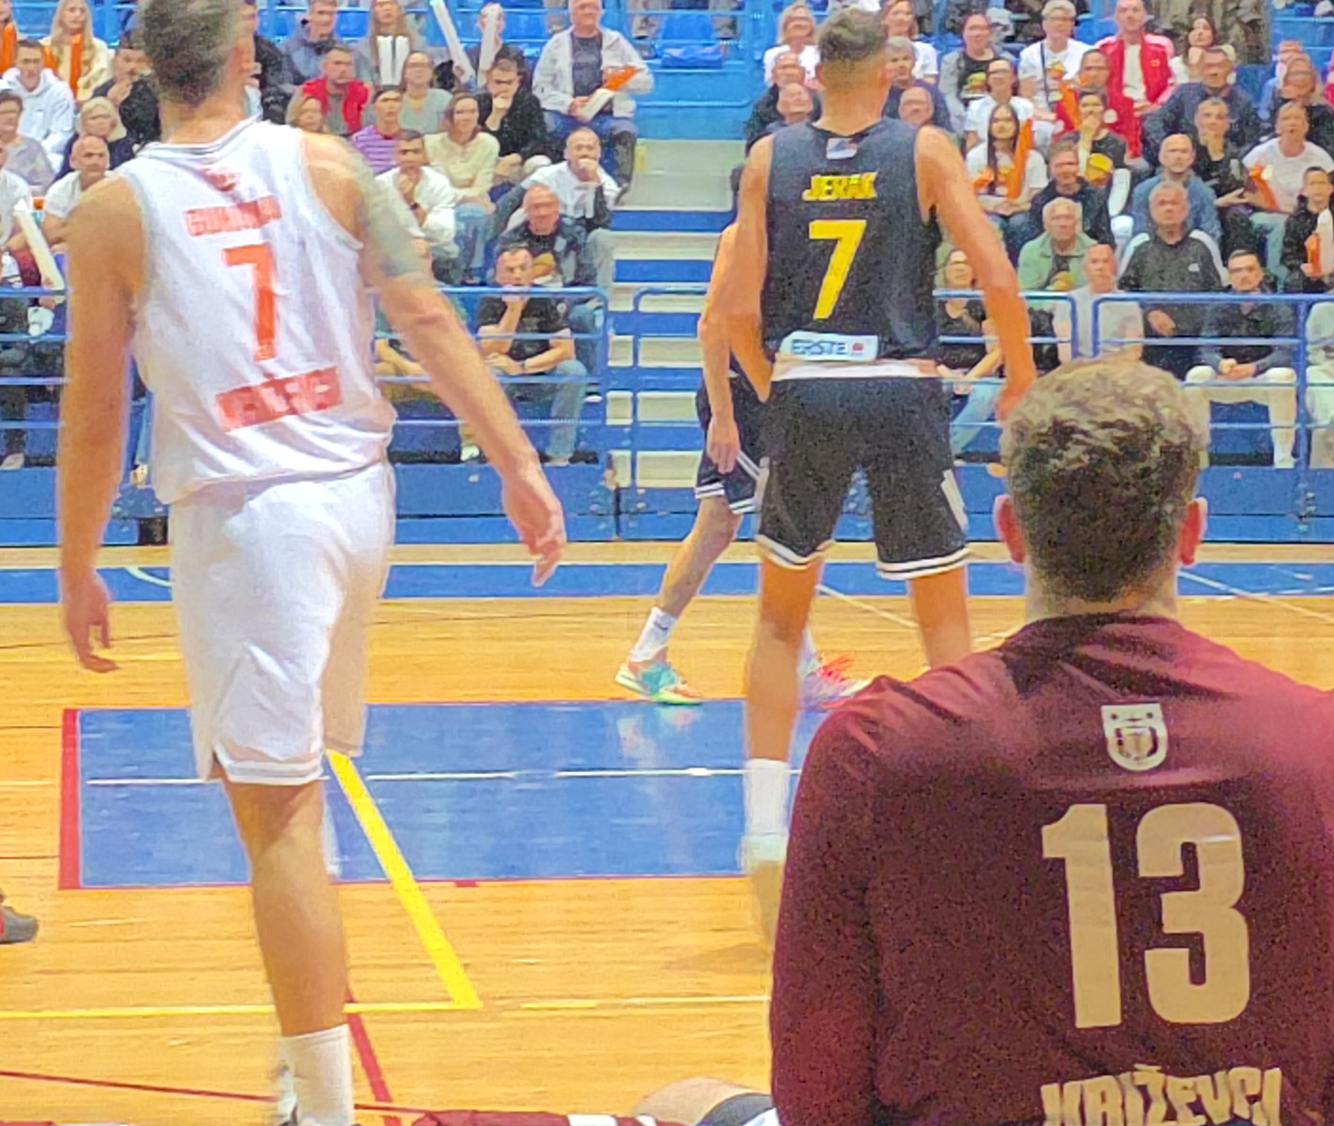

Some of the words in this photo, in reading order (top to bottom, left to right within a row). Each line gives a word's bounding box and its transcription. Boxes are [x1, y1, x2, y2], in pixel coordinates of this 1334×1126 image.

[222, 242, 276, 362] 7
[809, 220, 867, 320] 7
[1042, 803, 1251, 1029] 13
